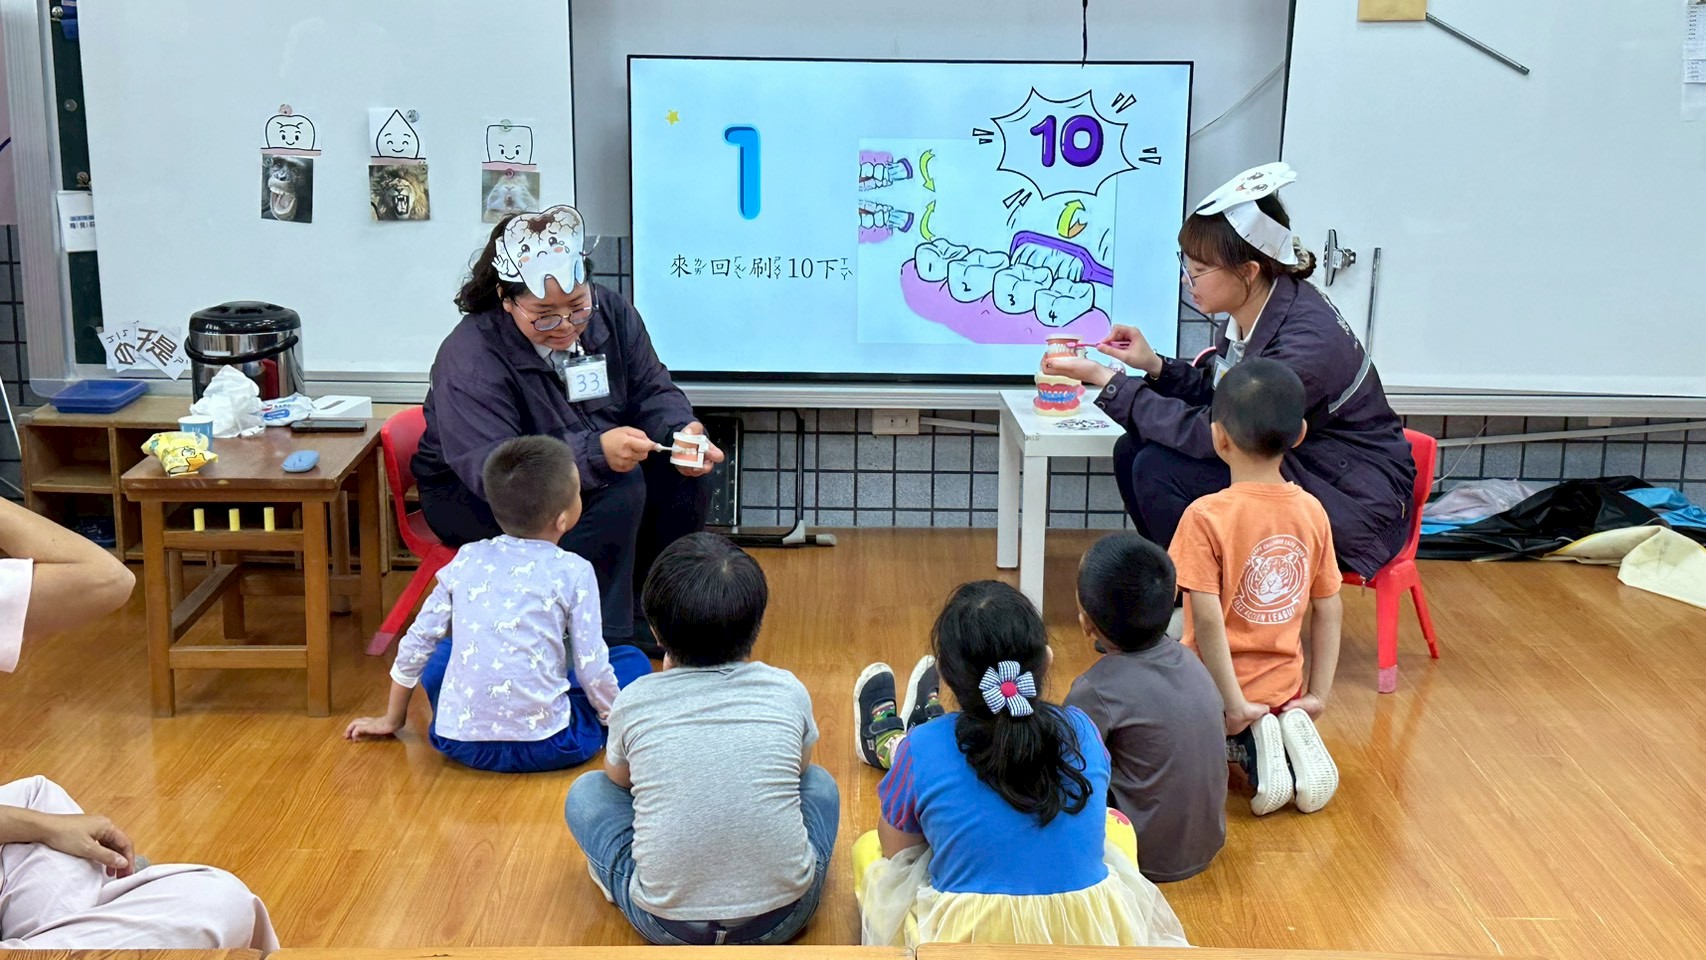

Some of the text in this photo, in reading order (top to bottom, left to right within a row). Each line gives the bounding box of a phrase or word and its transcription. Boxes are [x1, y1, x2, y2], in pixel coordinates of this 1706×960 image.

[1029, 114, 1104, 168] 10
[722, 123, 761, 220] 1
[961, 281, 971, 292] 2
[1007, 294, 1016, 306] 3
[1048, 310, 1058, 323] 4
[576, 371, 600, 393] 33
